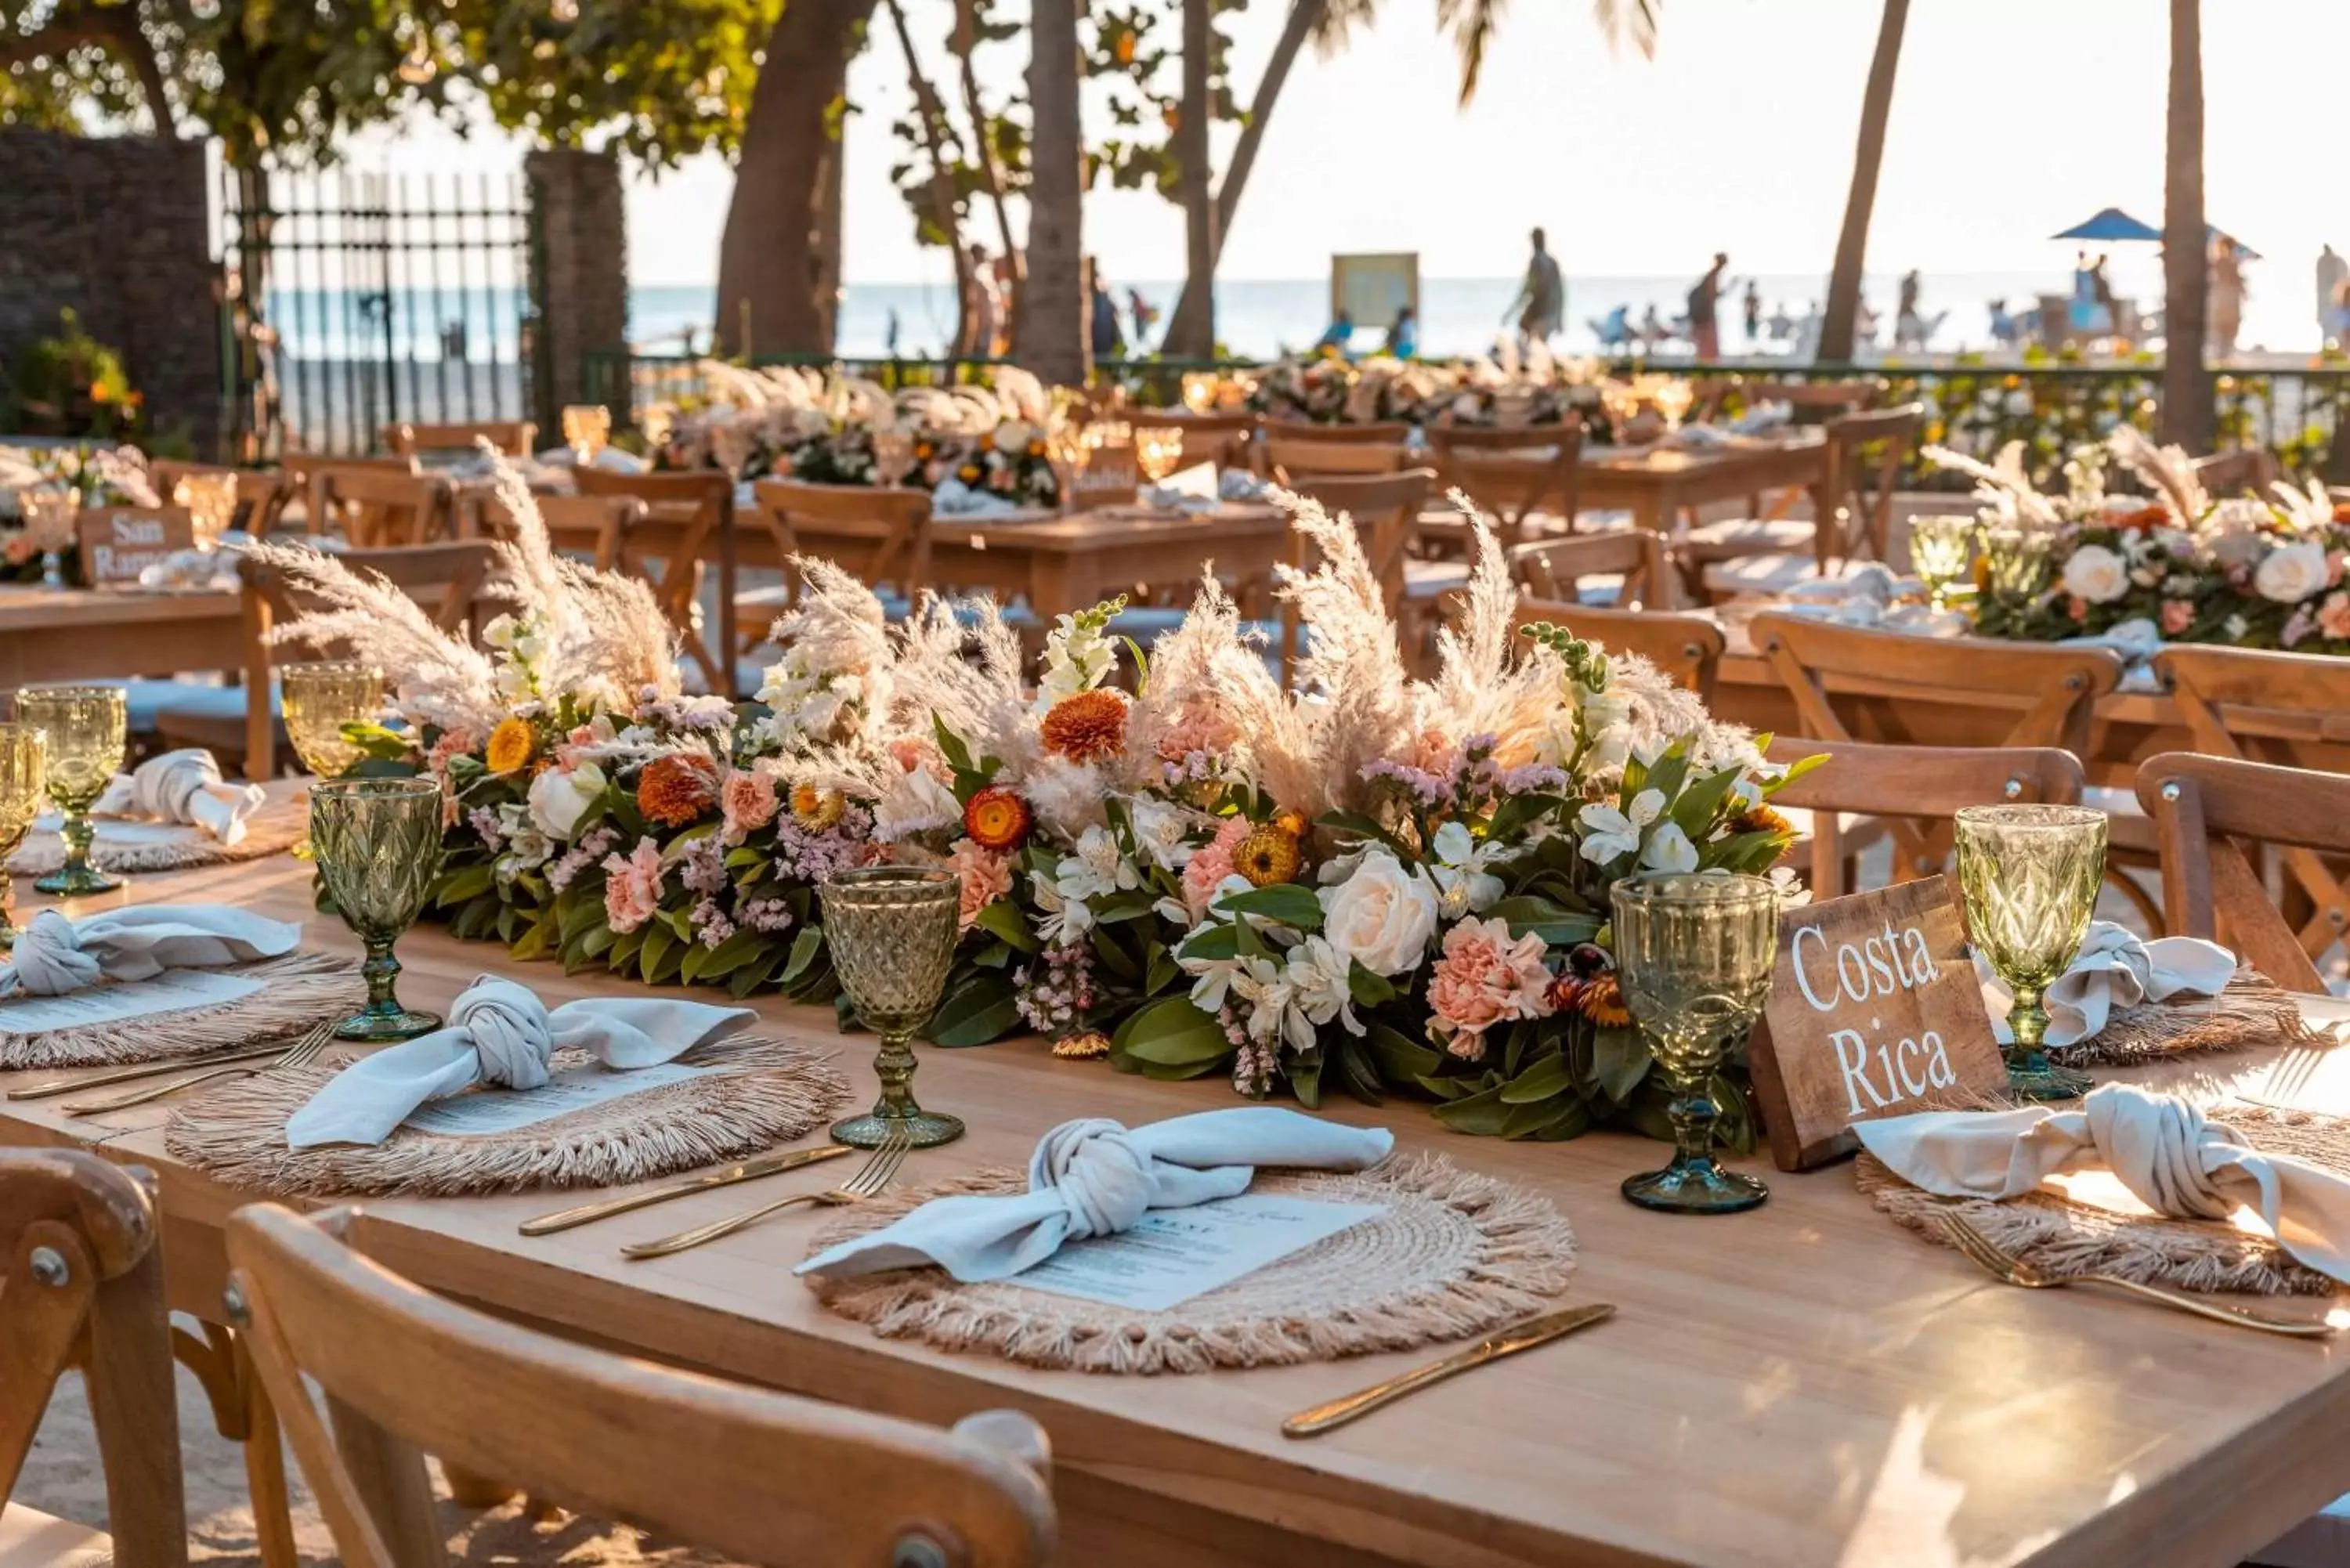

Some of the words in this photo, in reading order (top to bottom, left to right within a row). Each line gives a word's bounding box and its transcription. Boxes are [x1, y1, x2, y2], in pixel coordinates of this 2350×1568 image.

[112, 513, 164, 545] San
[1791, 918, 1940, 1012] Costa
[1828, 1017, 1957, 1117] Rica
